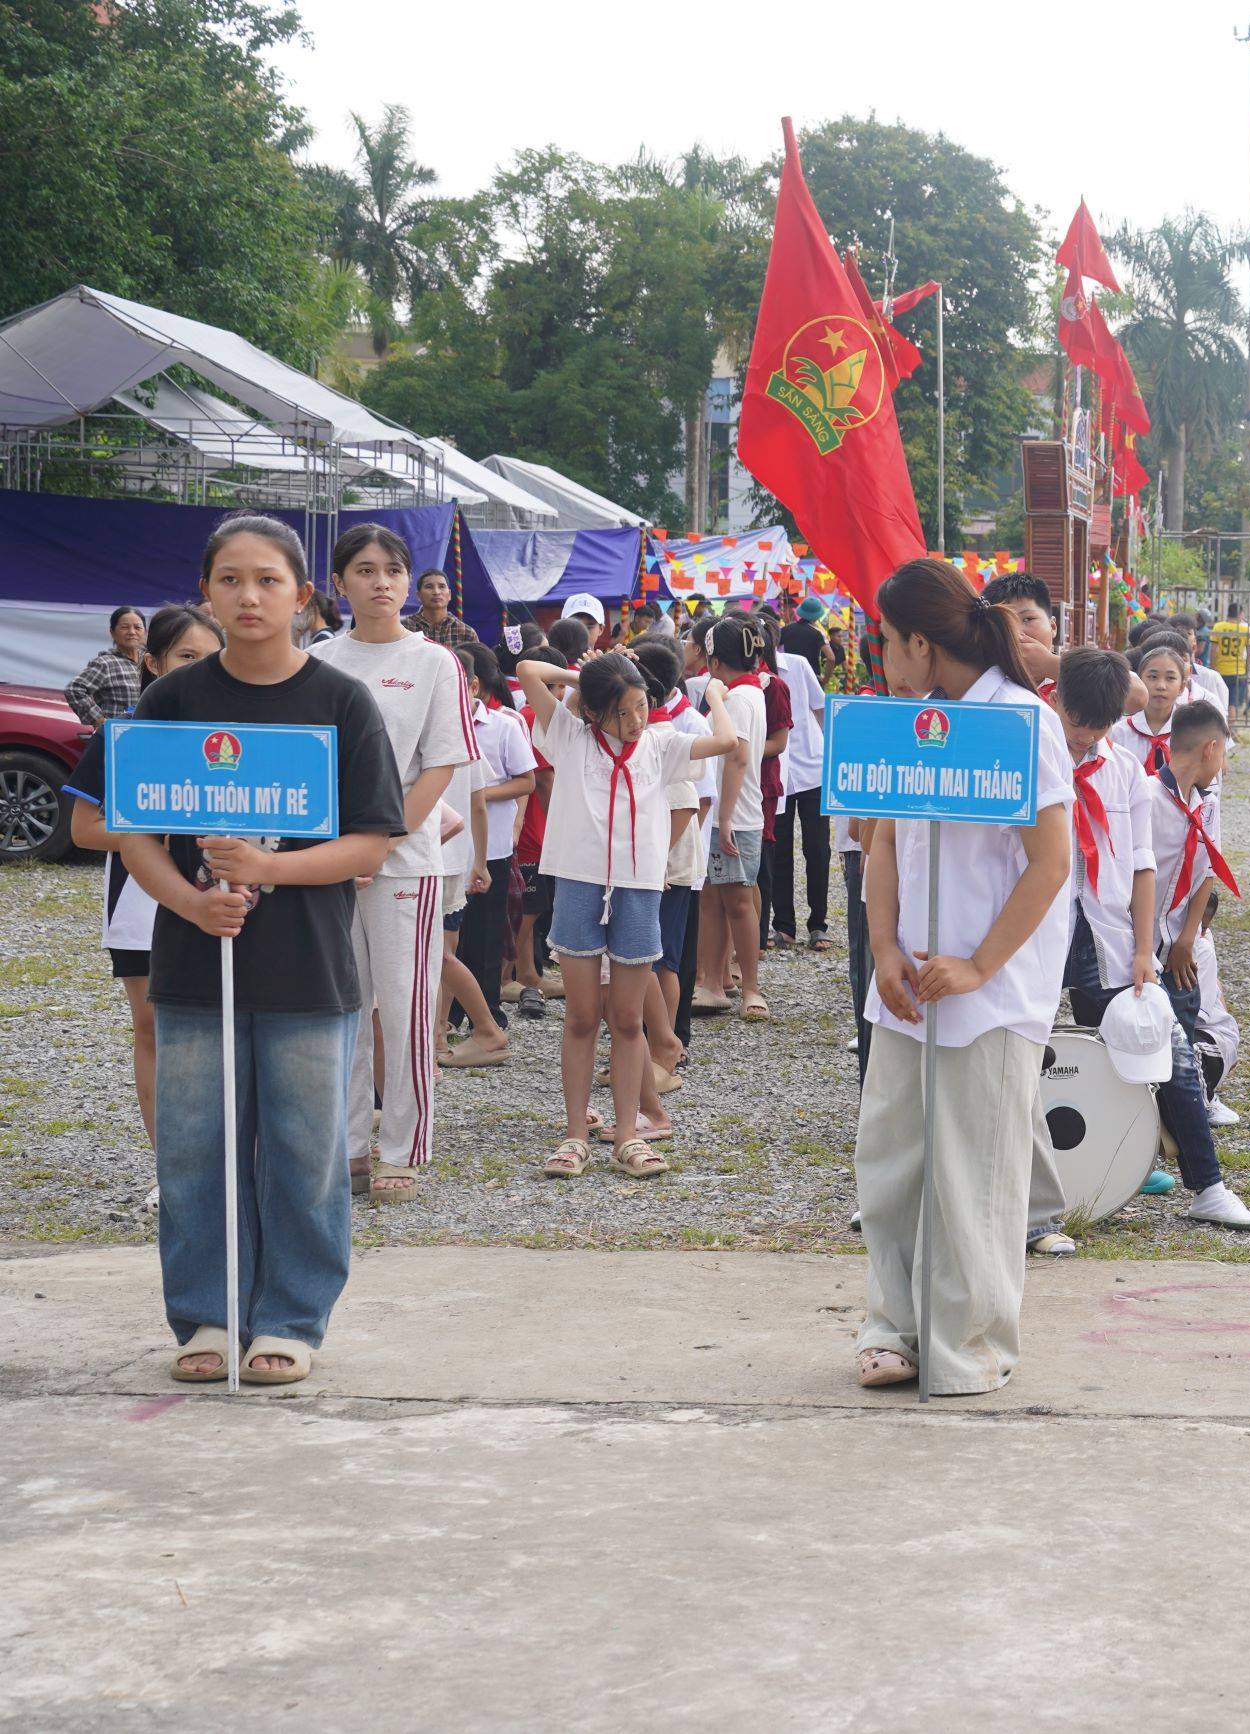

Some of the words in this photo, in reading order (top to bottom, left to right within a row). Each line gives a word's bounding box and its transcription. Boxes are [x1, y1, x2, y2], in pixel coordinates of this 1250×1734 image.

[137, 783, 166, 811] CHI
[171, 779, 199, 818] ĐỘI
[205, 781, 249, 813] THÔN
[255, 782, 281, 815] MỸ
[287, 782, 308, 815] RÉ
[838, 762, 862, 792] CHI
[867, 758, 892, 800] ĐỘI
[896, 760, 935, 796] THÔN
[940, 767, 968, 798] MAI
[973, 759, 1022, 800] THẮNG
[1049, 1066, 1079, 1075] YAMAHA
